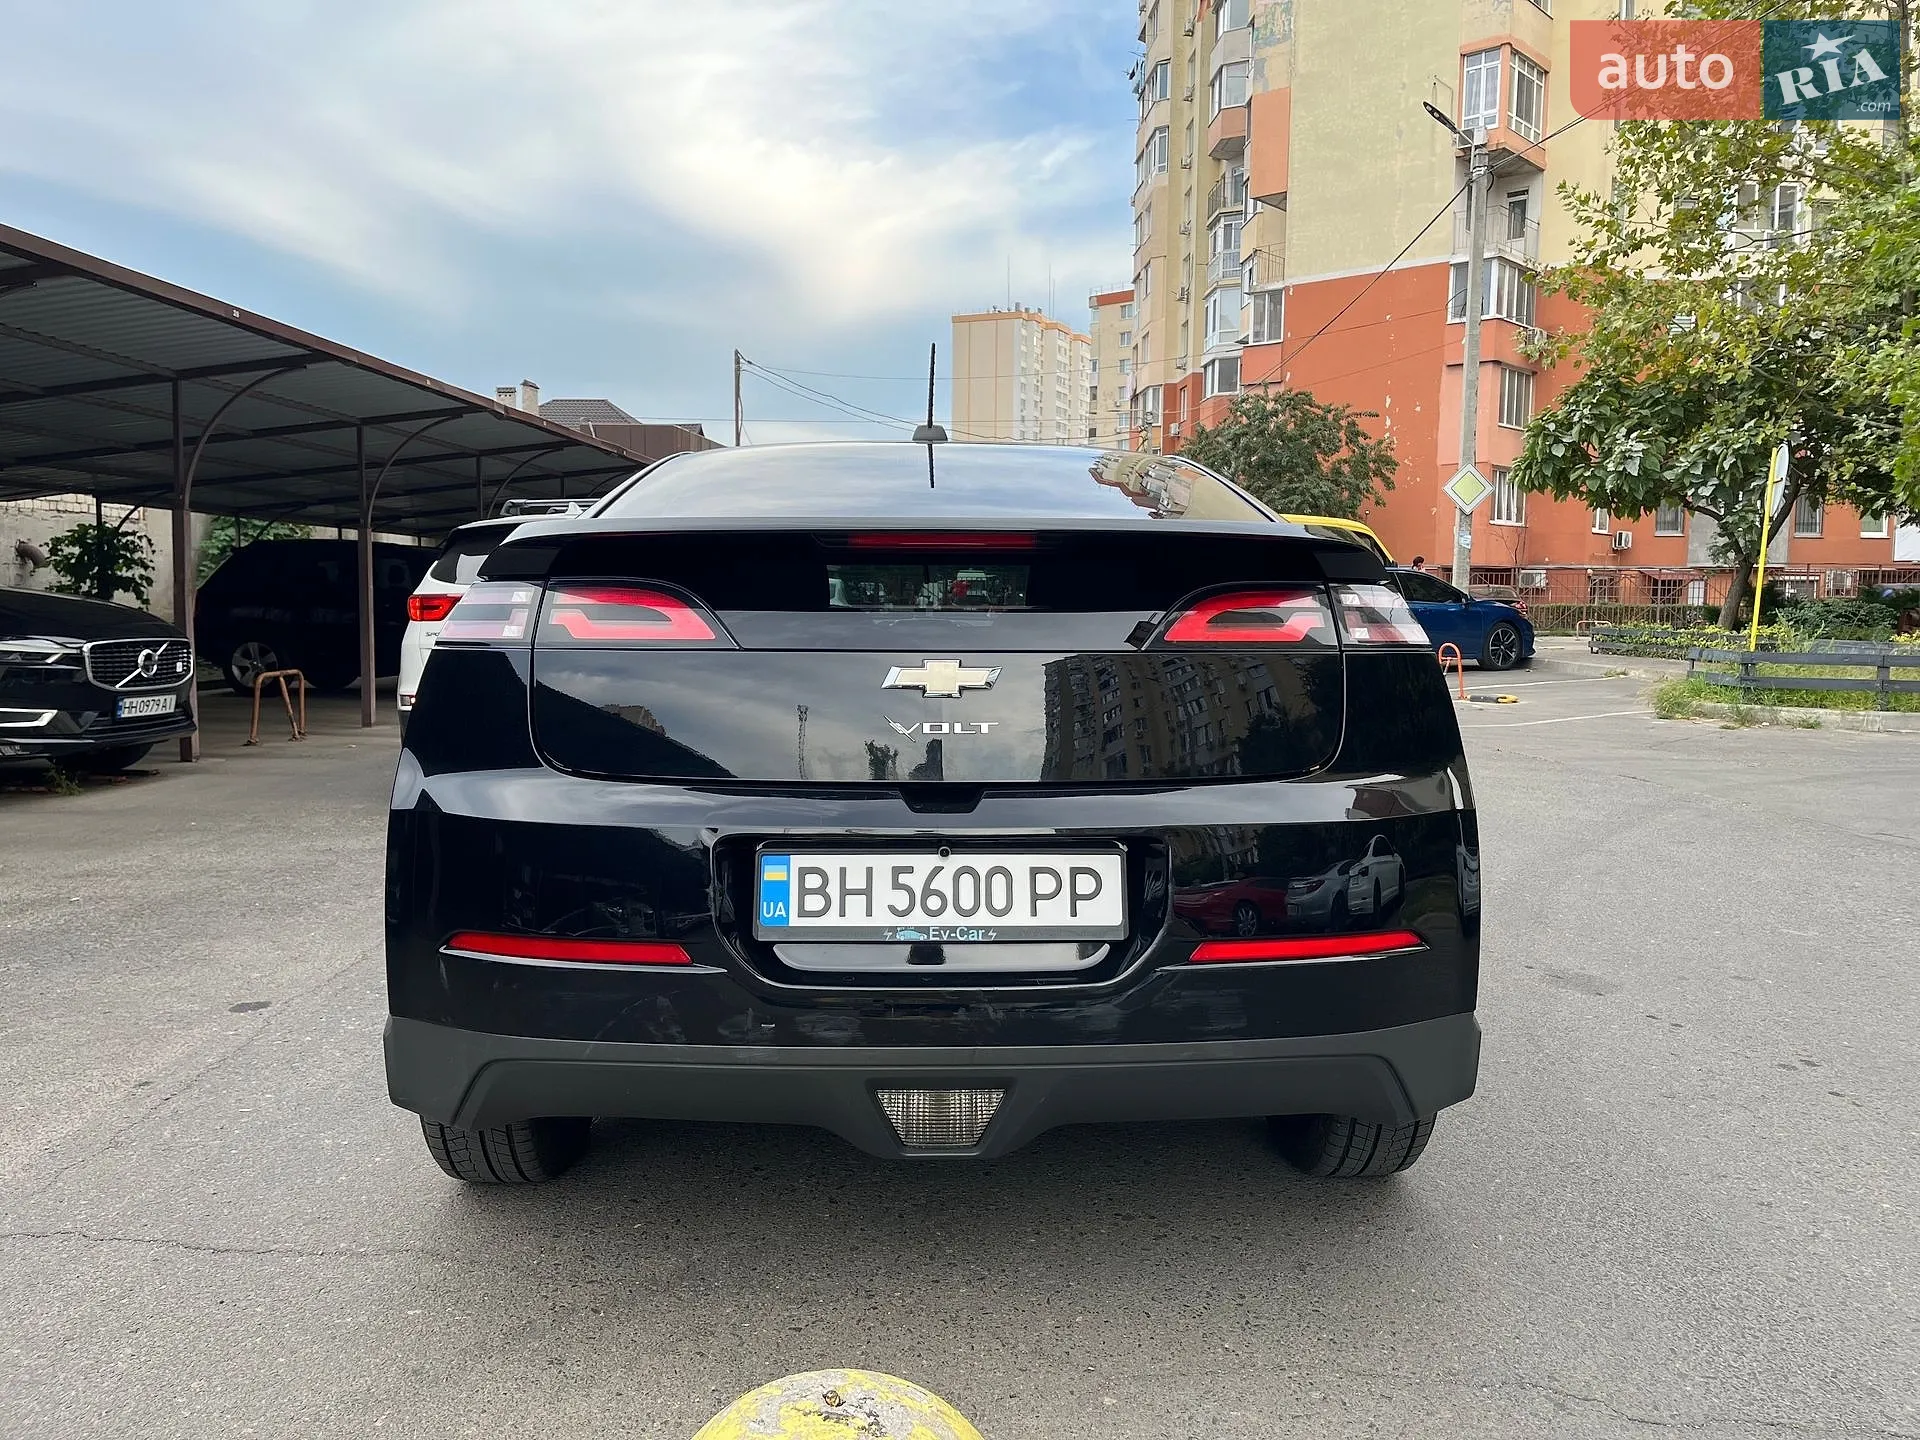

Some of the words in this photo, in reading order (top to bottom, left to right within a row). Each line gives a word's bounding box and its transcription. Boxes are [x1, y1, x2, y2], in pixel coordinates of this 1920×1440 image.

[884, 715, 1000, 742] VOLT
[797, 866, 874, 918] BH
[887, 865, 1014, 918] 5600
[1030, 866, 1103, 918] PP
[763, 902, 787, 918] UA
[929, 926, 985, 941] Ev-Car
